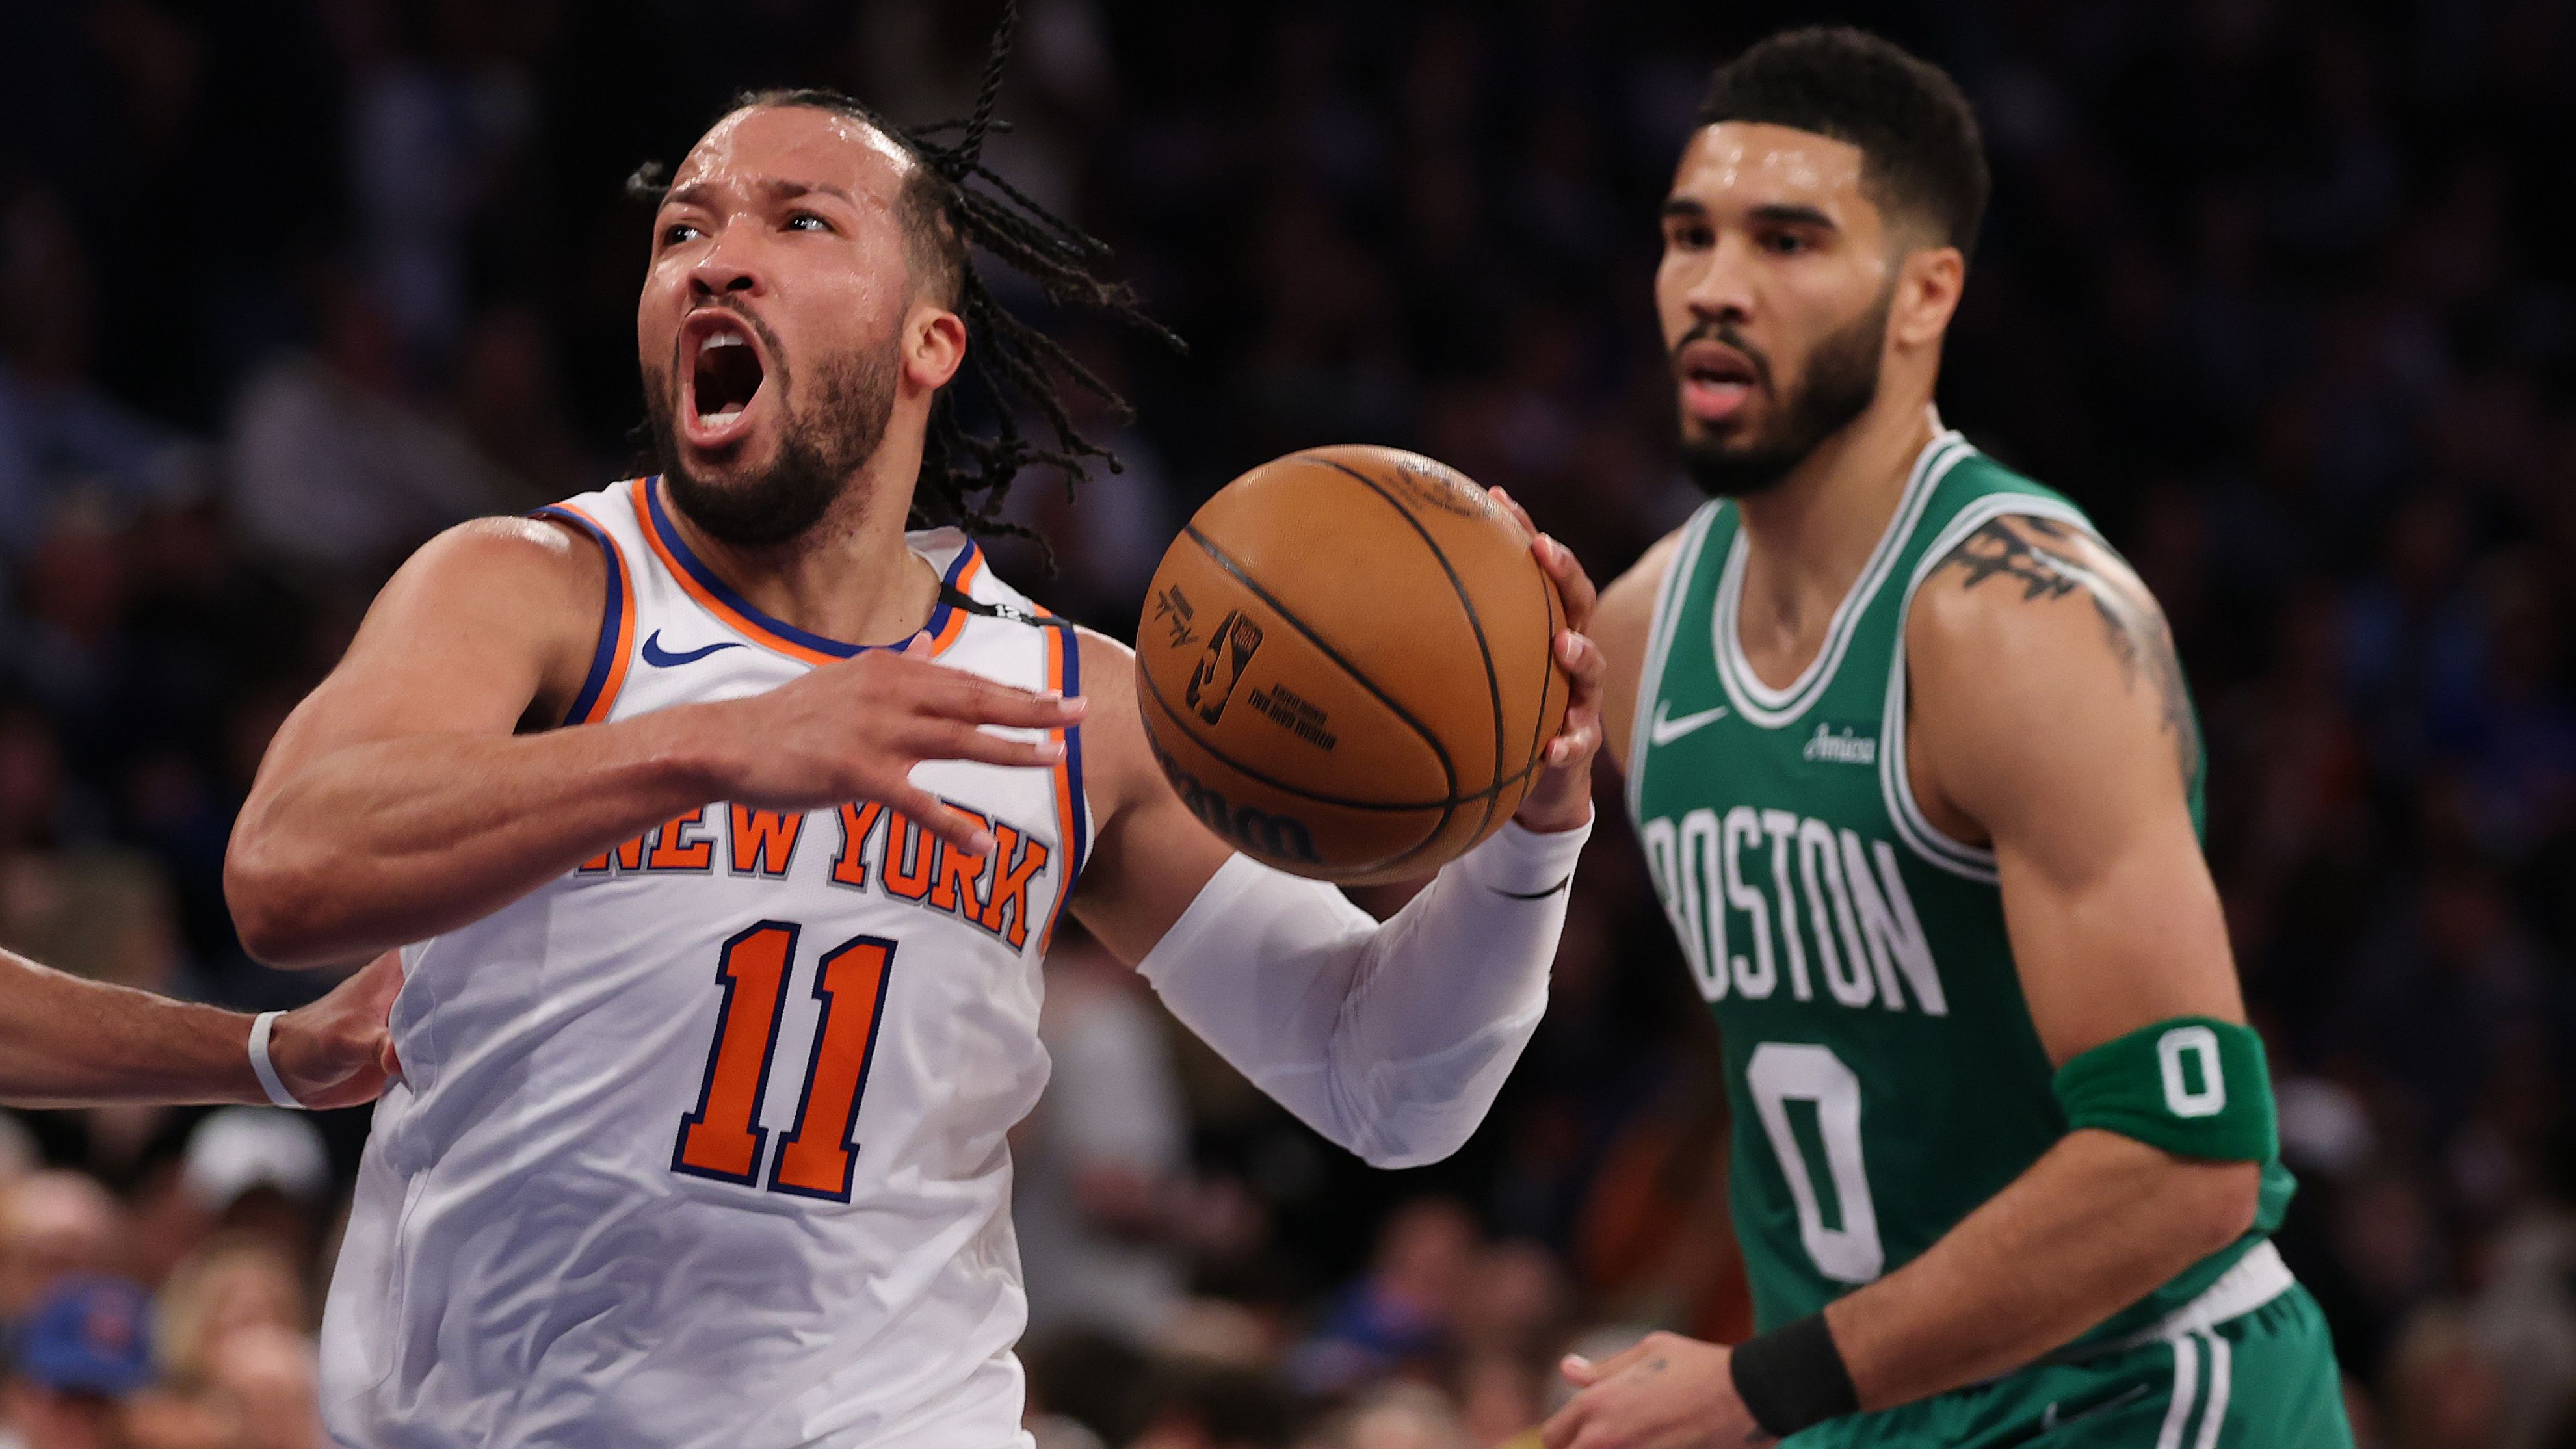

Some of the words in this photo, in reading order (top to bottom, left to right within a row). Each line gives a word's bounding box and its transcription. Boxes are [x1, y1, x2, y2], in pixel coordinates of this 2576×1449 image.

[827, 794, 1049, 958] YORK
[670, 919, 899, 1203] 11
[2157, 1025, 2226, 1118] 0
[1746, 1043, 1884, 1283] 0
